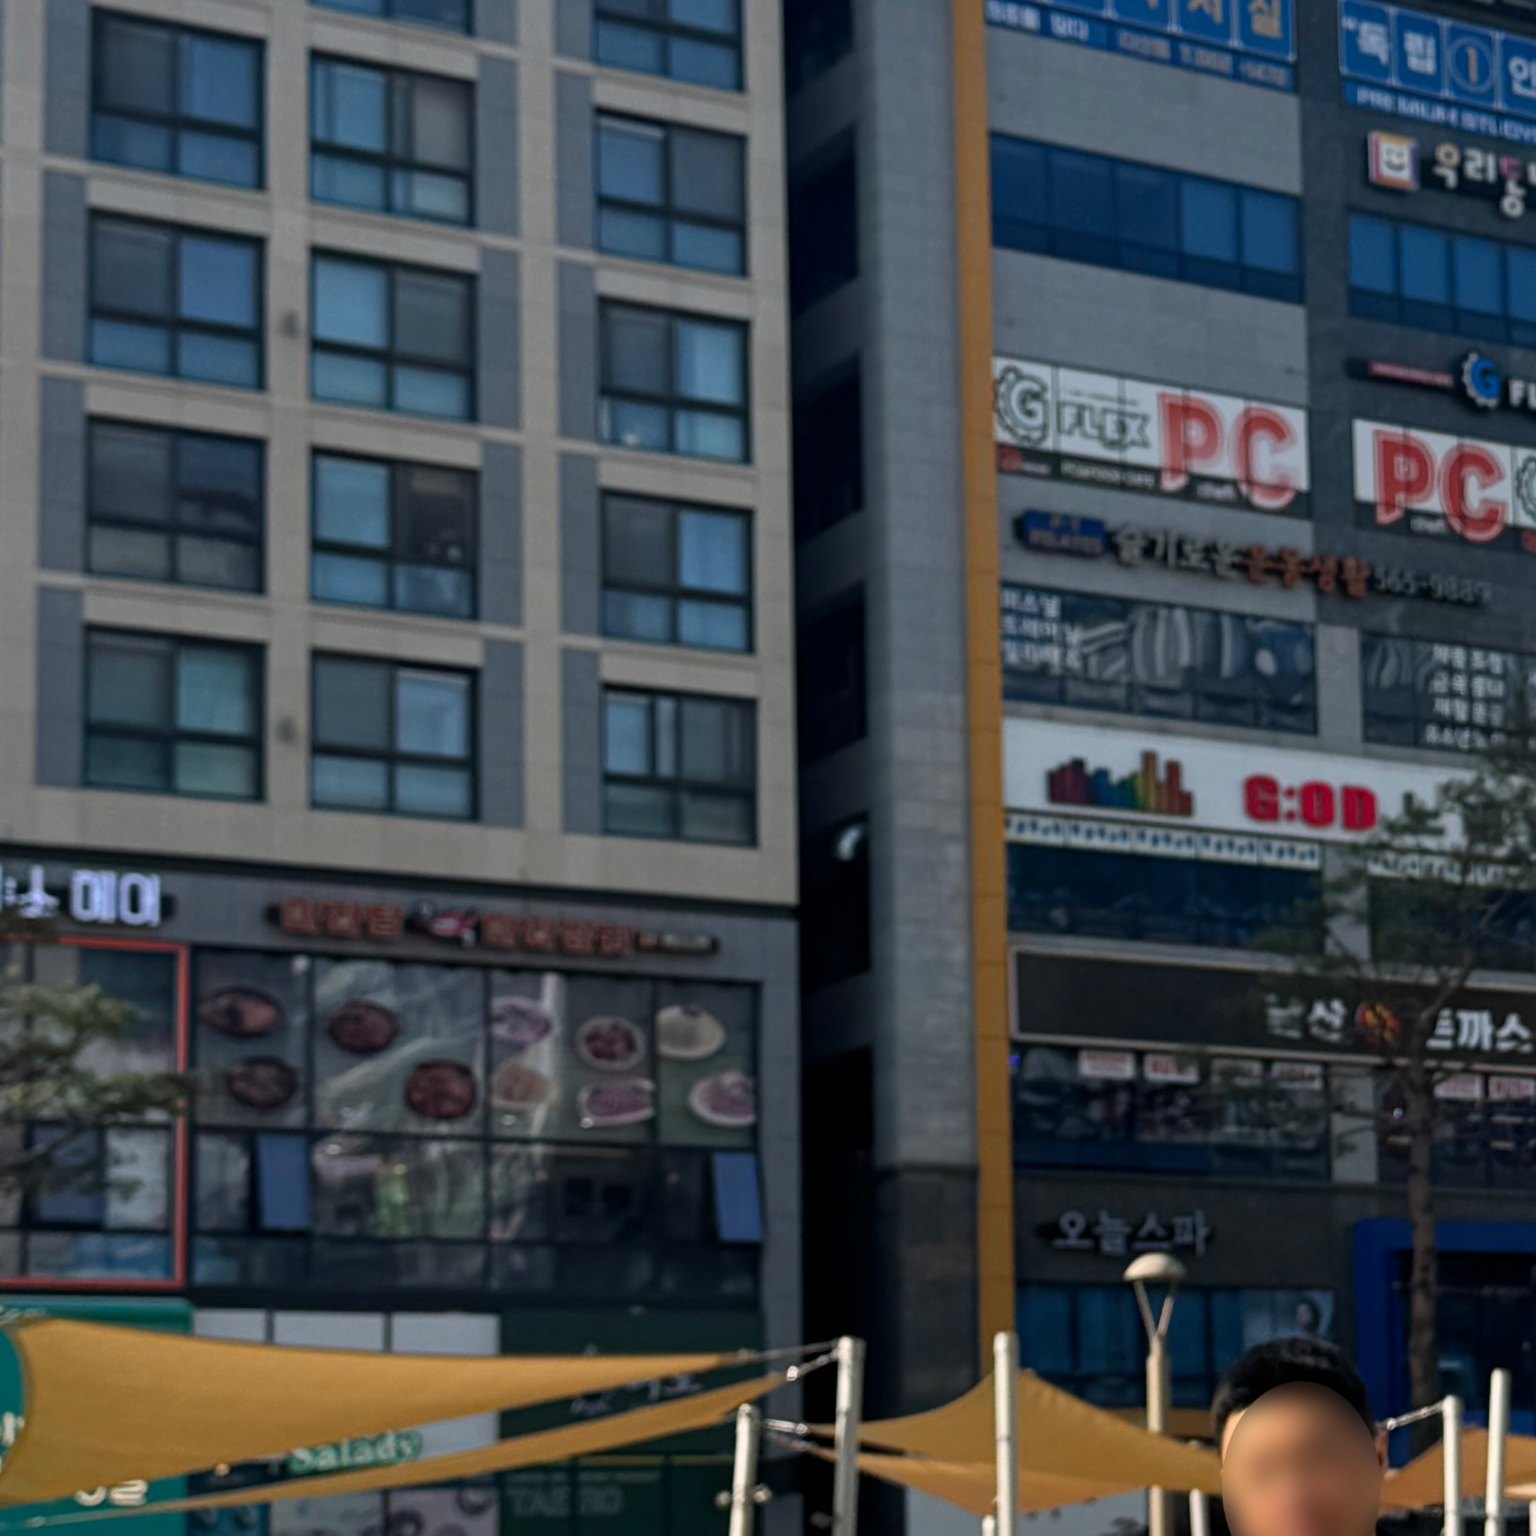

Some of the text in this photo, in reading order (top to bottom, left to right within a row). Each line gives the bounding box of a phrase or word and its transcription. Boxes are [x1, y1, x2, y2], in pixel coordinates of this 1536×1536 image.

[1158, 390, 1299, 510] PC
[1373, 429, 1507, 543] PC
[1051, 1209, 1210, 1259] 오늘스파
